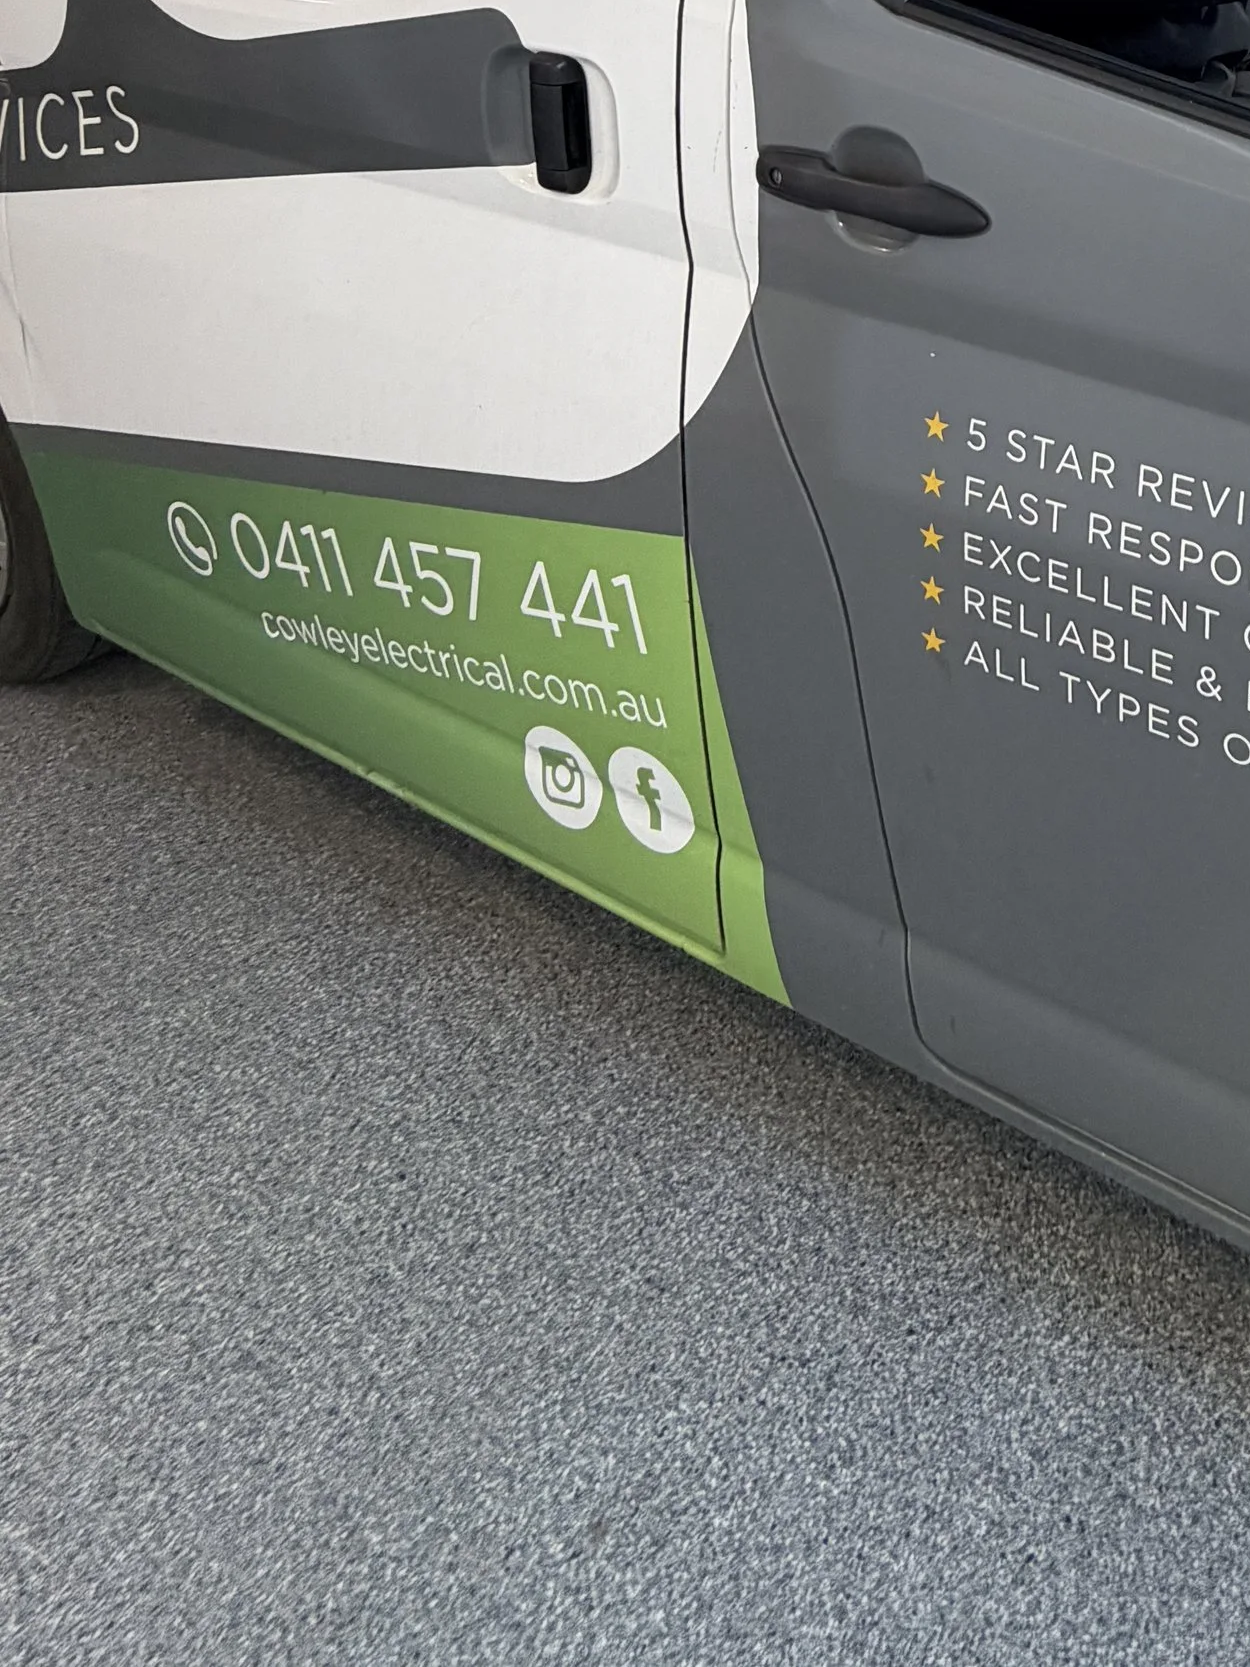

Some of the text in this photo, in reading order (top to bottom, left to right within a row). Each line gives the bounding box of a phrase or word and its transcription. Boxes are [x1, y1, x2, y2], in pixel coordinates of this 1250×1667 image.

[964, 475, 1068, 534] FAST
[966, 417, 987, 452] 5
[1006, 429, 1115, 489] STAR
[230, 512, 648, 655] 0411 457 441
[963, 531, 1221, 640] EXCELLENT
[261, 612, 668, 729] cowleyelectrical.com.au
[963, 585, 1174, 686] RELIABLE
[1195, 665, 1223, 702] &
[963, 640, 1040, 692] ALL
[1058, 670, 1200, 748] TYPES
